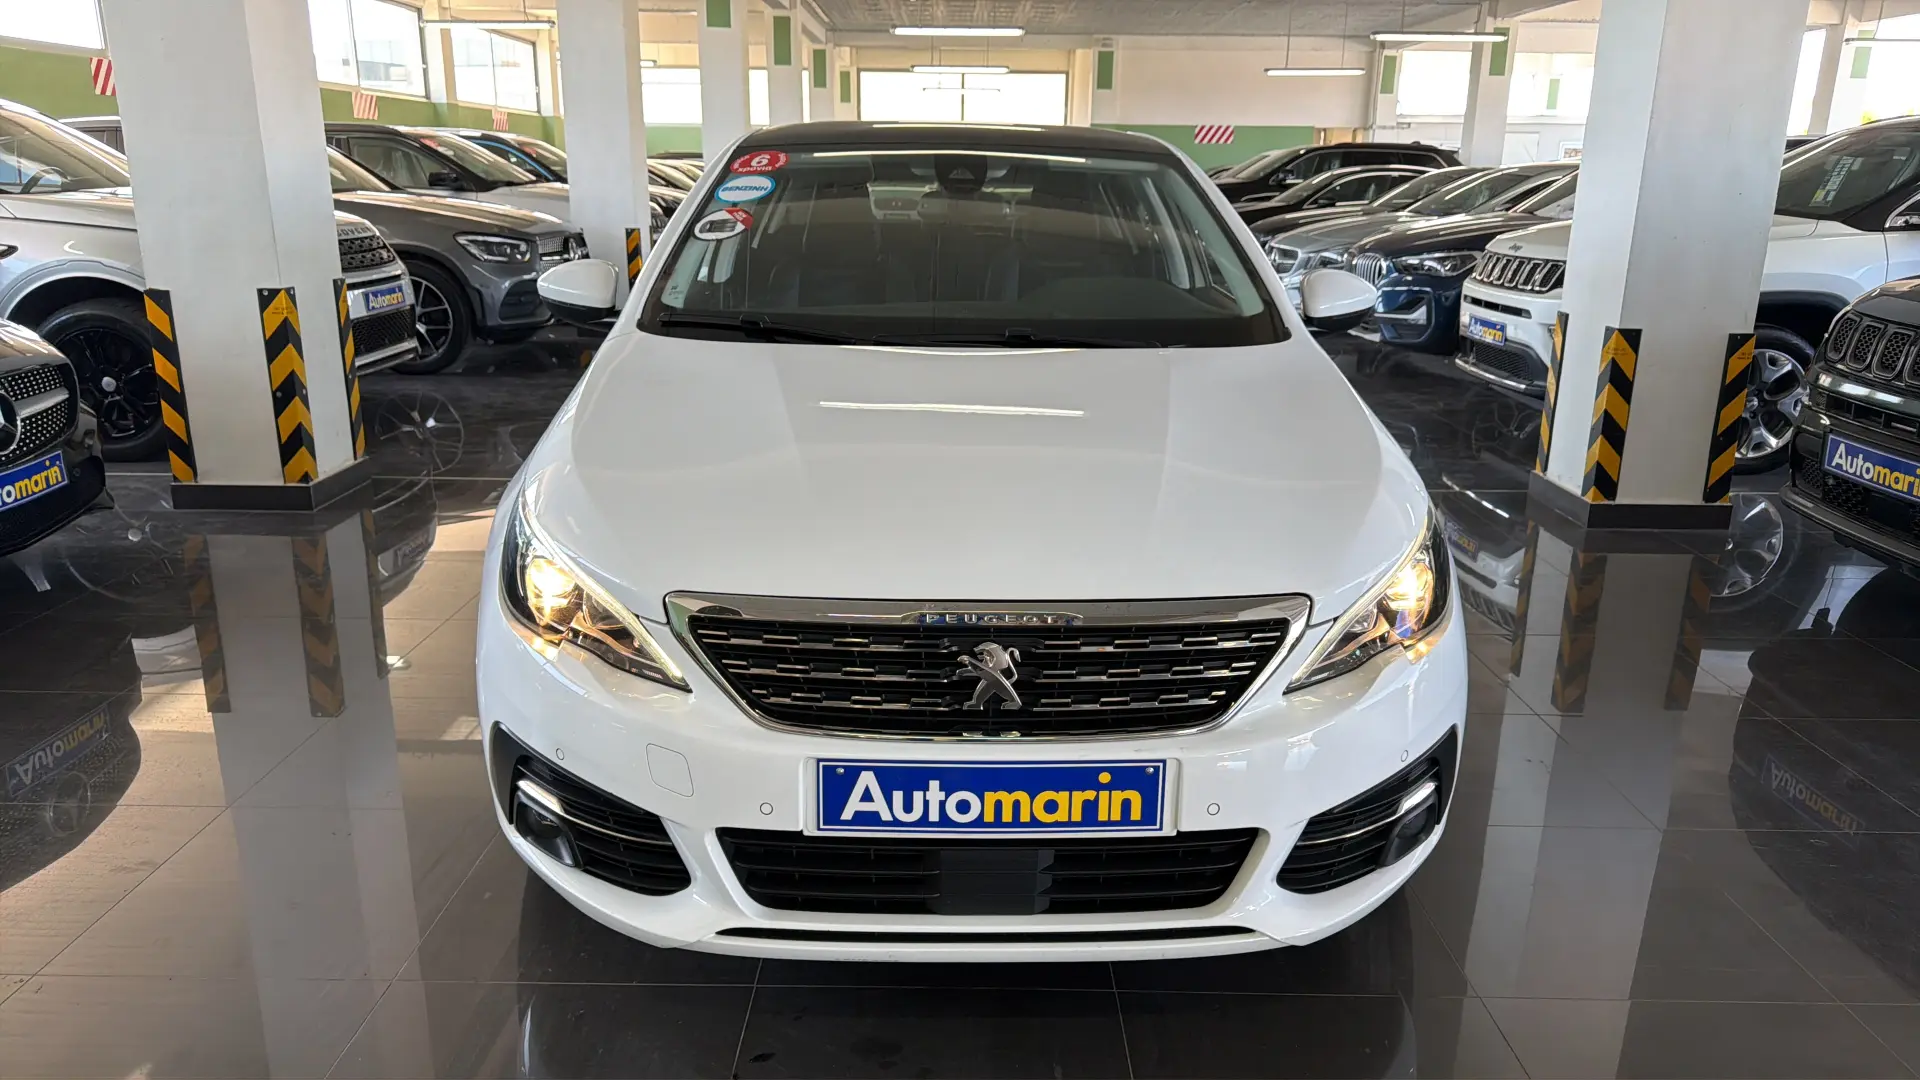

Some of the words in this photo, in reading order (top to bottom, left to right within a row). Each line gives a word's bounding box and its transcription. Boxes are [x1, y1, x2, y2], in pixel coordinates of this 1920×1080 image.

[751, 154, 771, 167] 6
[369, 287, 404, 310] Automarin
[926, 614, 1057, 624] PEUGEOT
[840, 770, 1142, 823] Automarin
